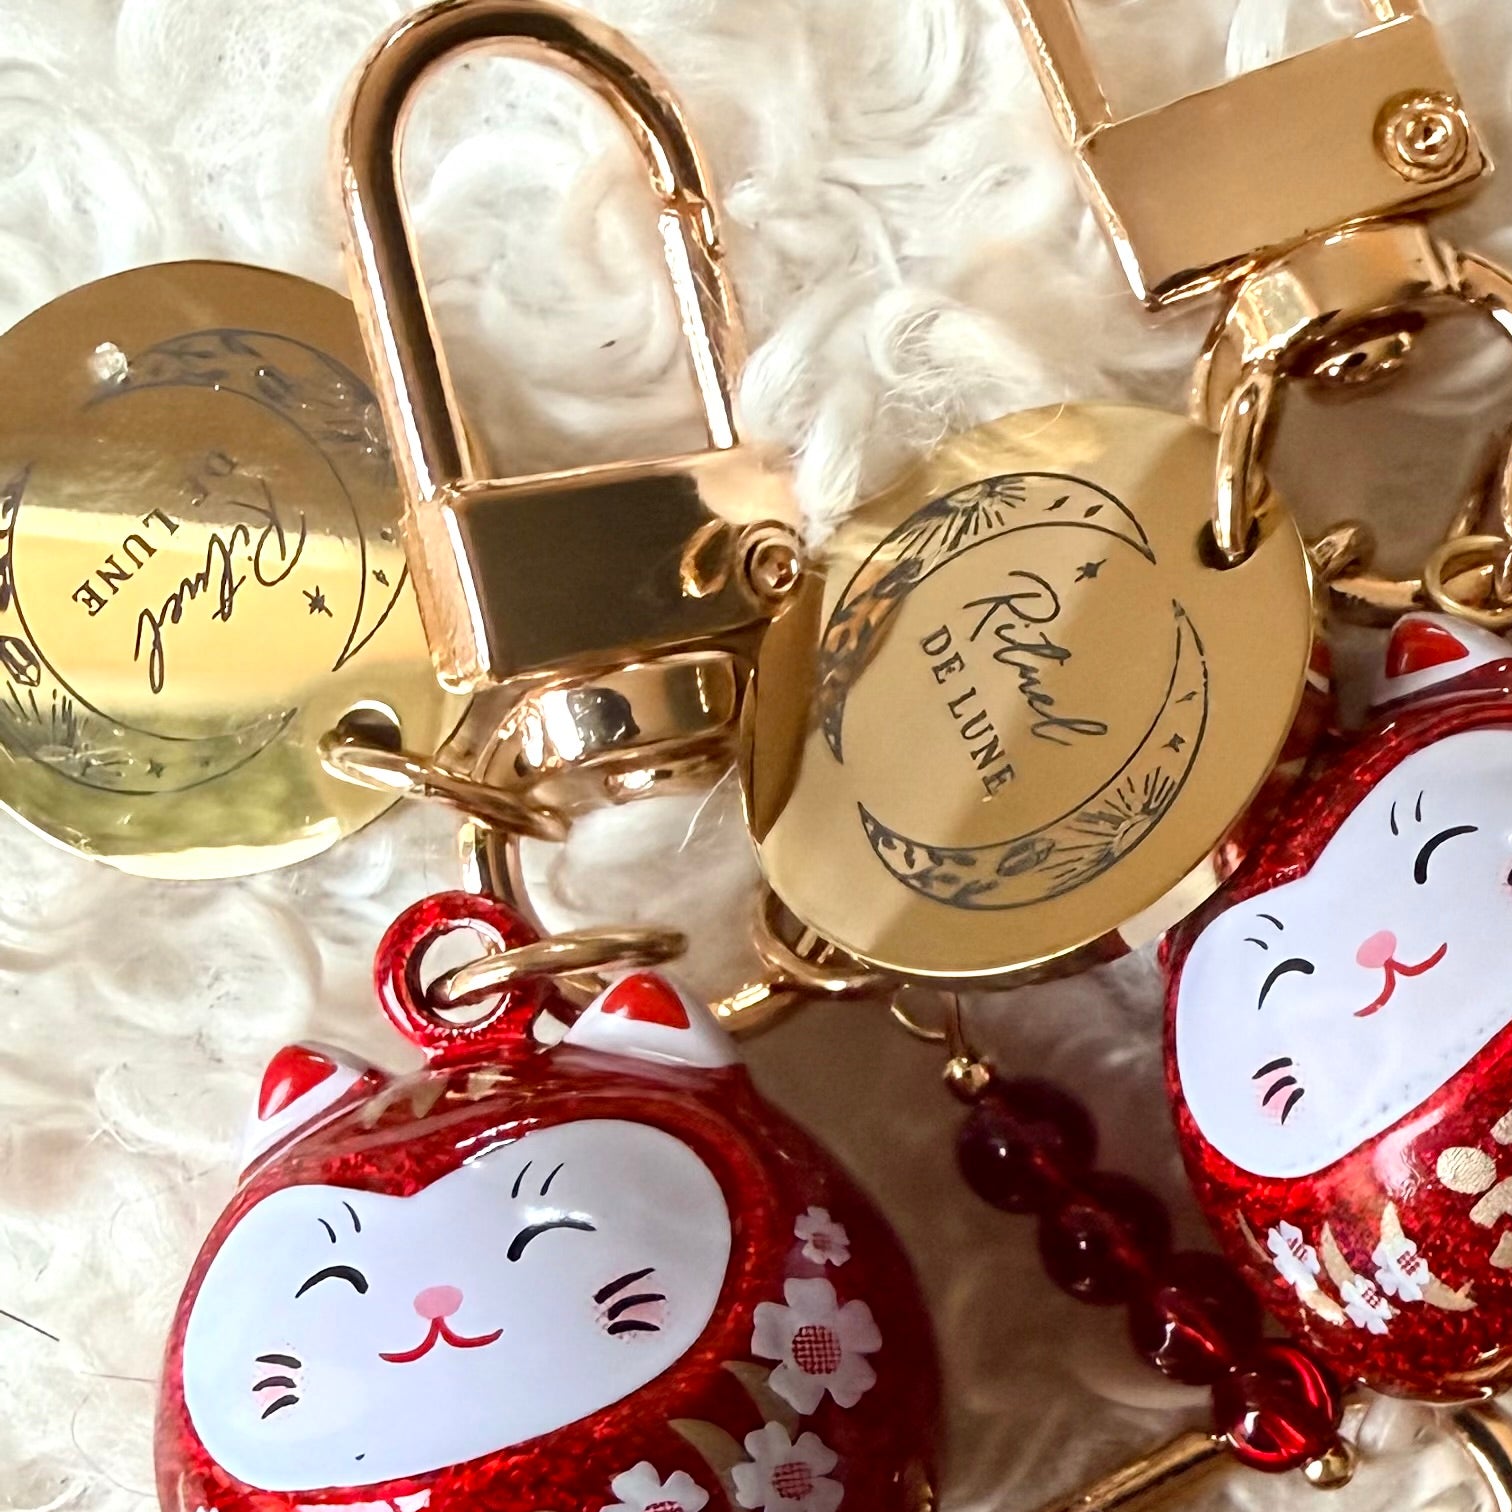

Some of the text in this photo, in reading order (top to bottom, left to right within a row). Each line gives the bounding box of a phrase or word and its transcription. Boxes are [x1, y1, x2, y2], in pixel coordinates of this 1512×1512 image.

[72, 507, 180, 617] LUNE
[920, 624, 1016, 796] DE LUNE
